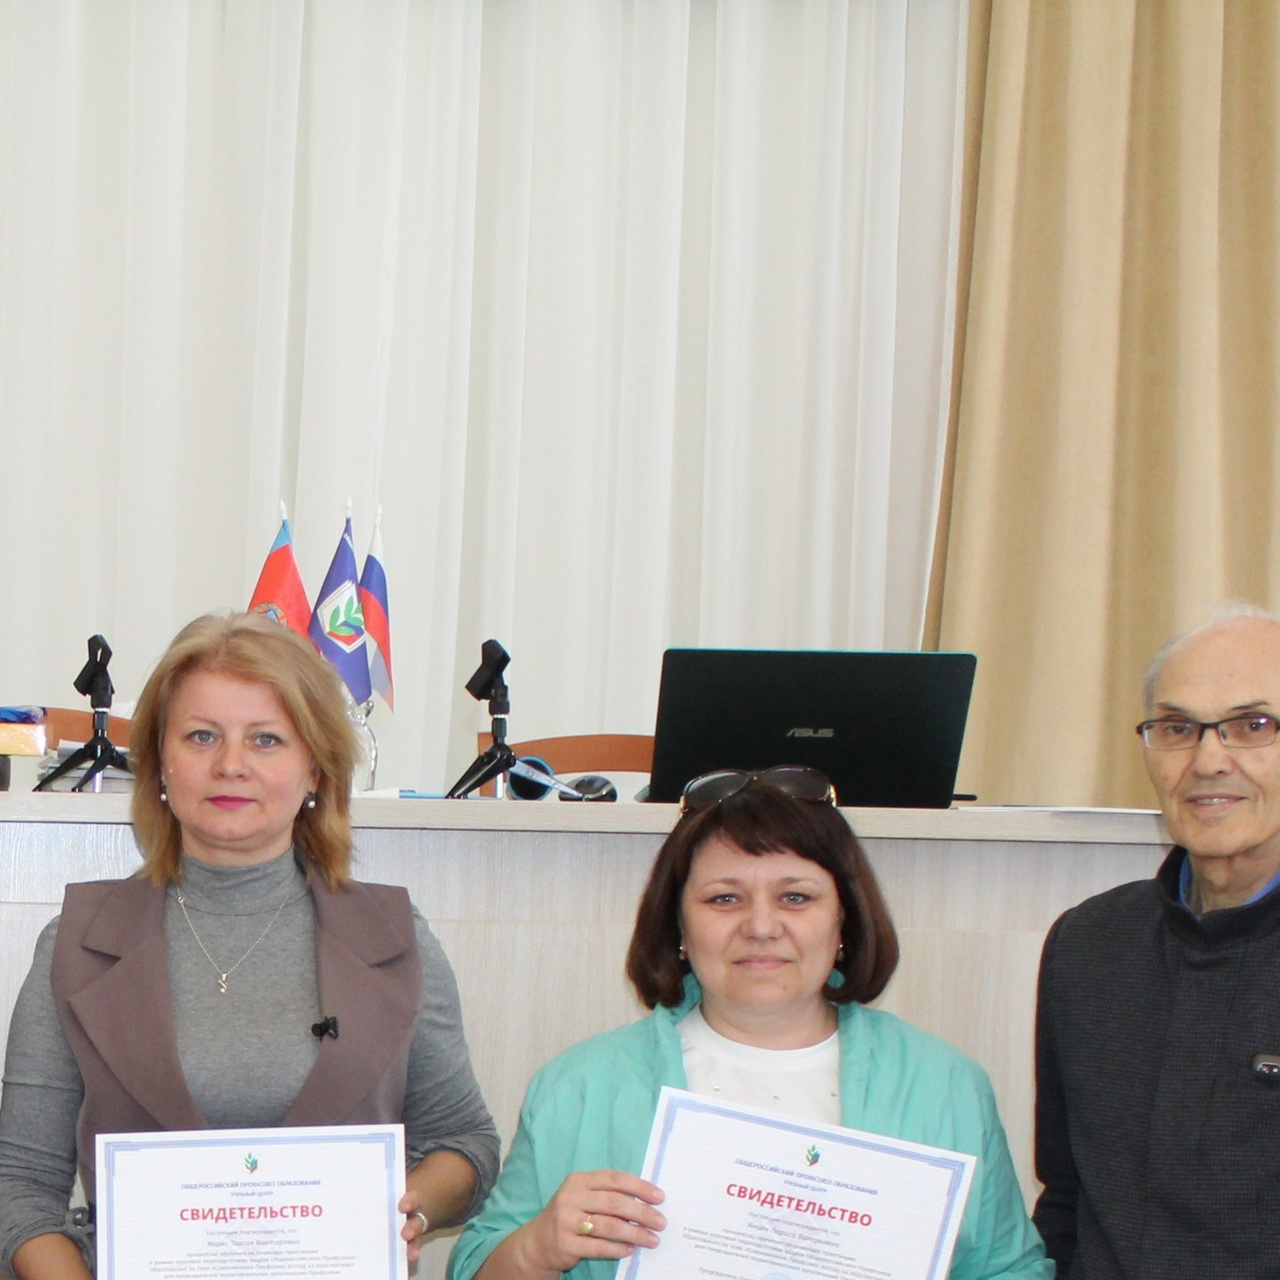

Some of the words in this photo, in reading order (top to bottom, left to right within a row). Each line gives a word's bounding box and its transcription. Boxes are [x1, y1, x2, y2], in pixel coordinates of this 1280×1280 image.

[786, 728, 835, 738] ASUS
[180, 1205, 322, 1223] СВИДЕТЕЛЬСТВО
[727, 1184, 871, 1226] СВИДЕТЕЛЬСТВО
